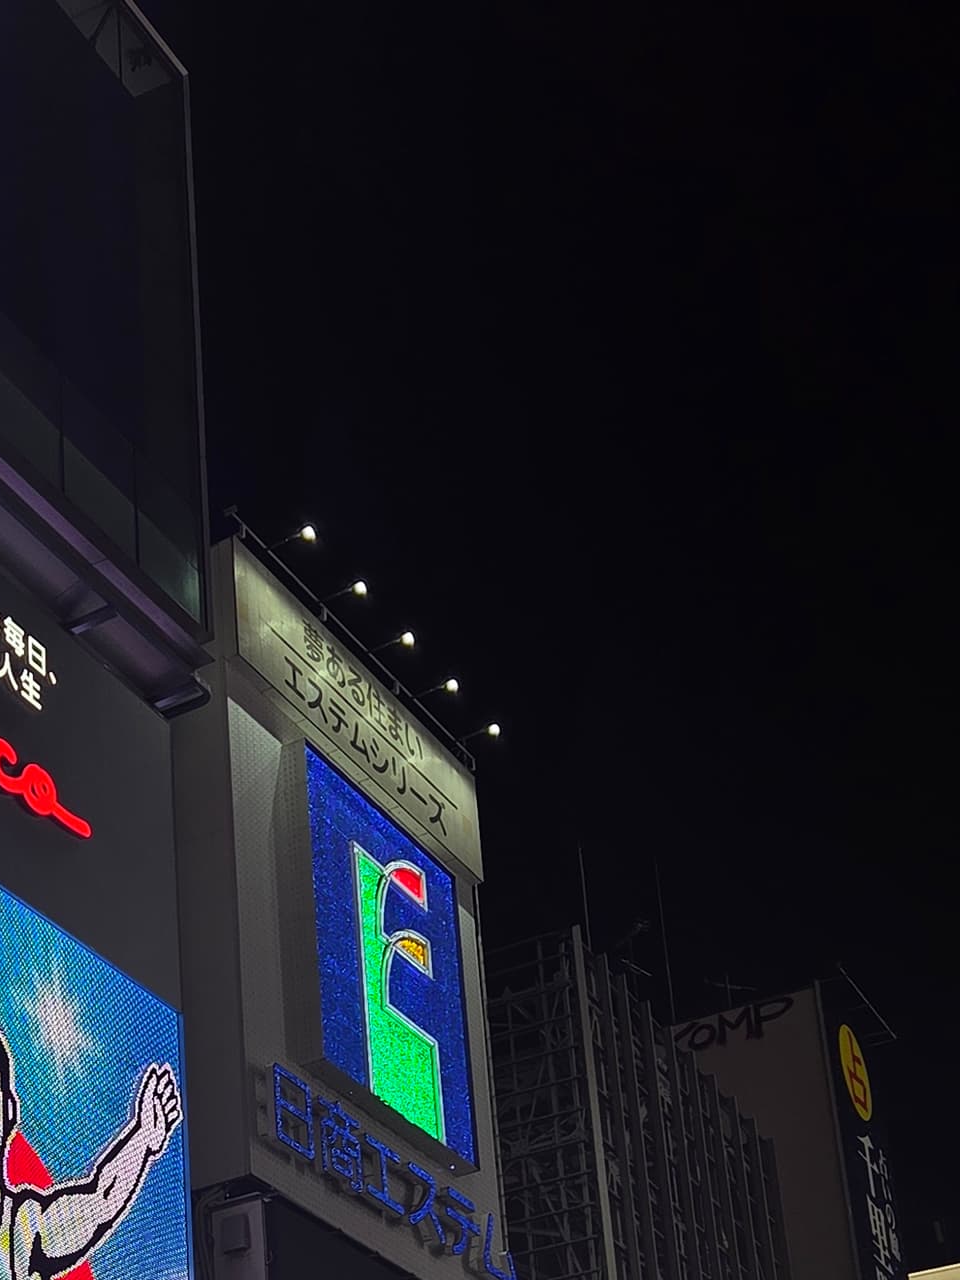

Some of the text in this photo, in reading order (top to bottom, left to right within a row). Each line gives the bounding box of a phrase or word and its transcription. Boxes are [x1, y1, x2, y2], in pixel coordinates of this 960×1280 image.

[283, 656, 448, 837] エステムシリーズ
[301, 617, 425, 764] 夢ある住まい
